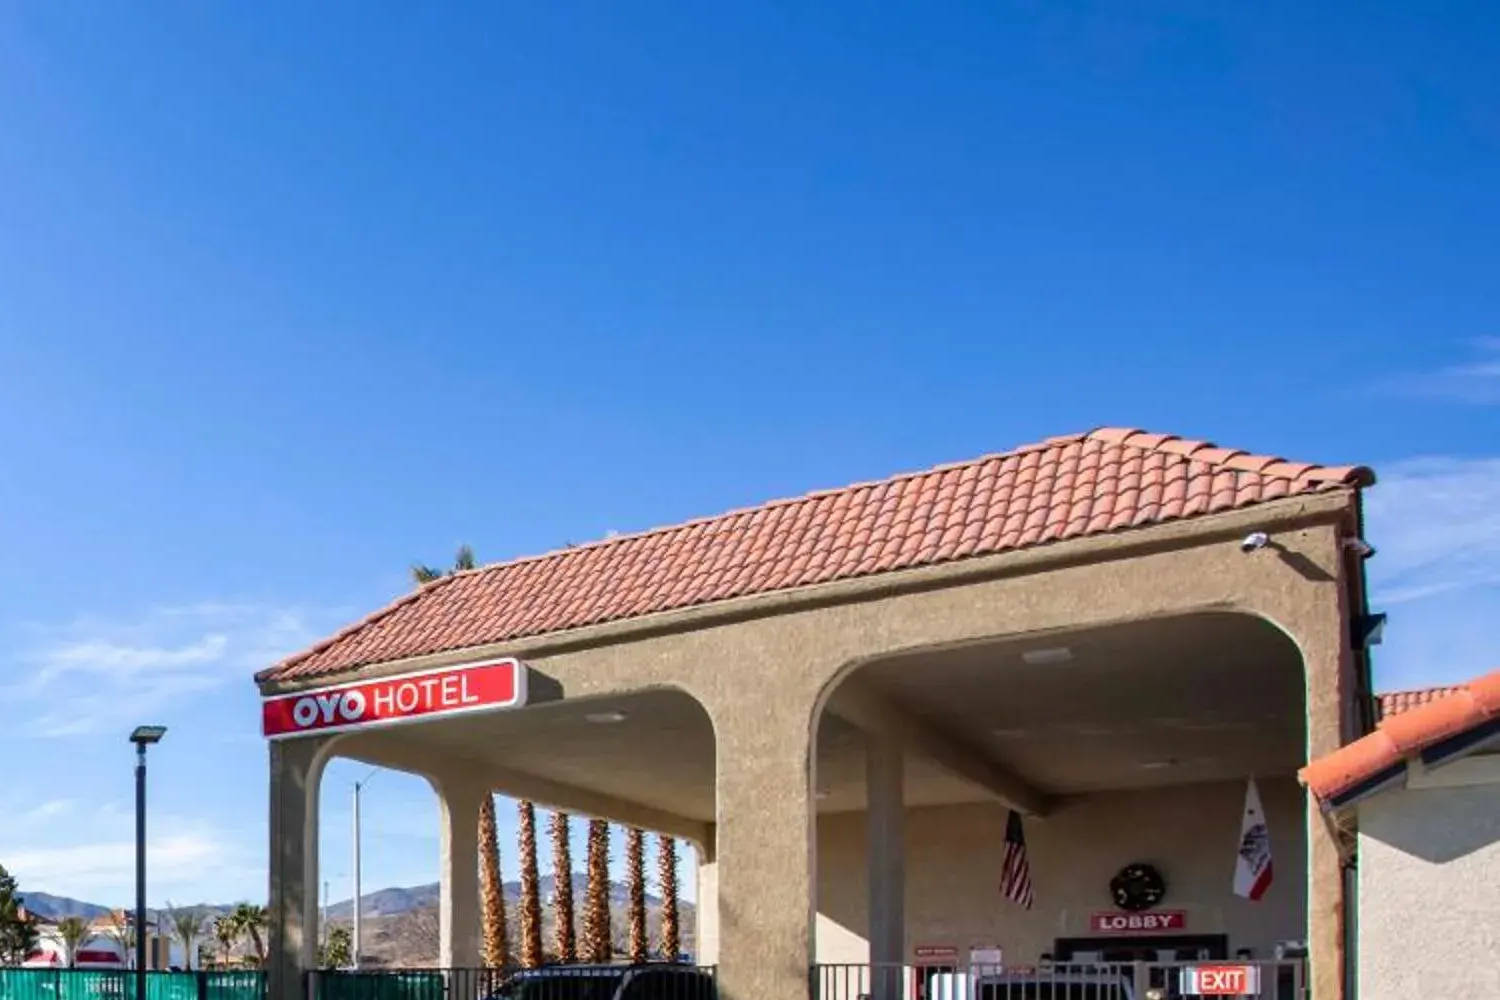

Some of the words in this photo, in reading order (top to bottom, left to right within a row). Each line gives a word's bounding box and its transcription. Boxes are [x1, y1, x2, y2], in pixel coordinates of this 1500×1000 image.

[293, 690, 365, 727] OYO
[374, 673, 478, 715] HOTEL
[1100, 915, 1172, 929] LOBBY
[1201, 970, 1243, 989] EXIT
